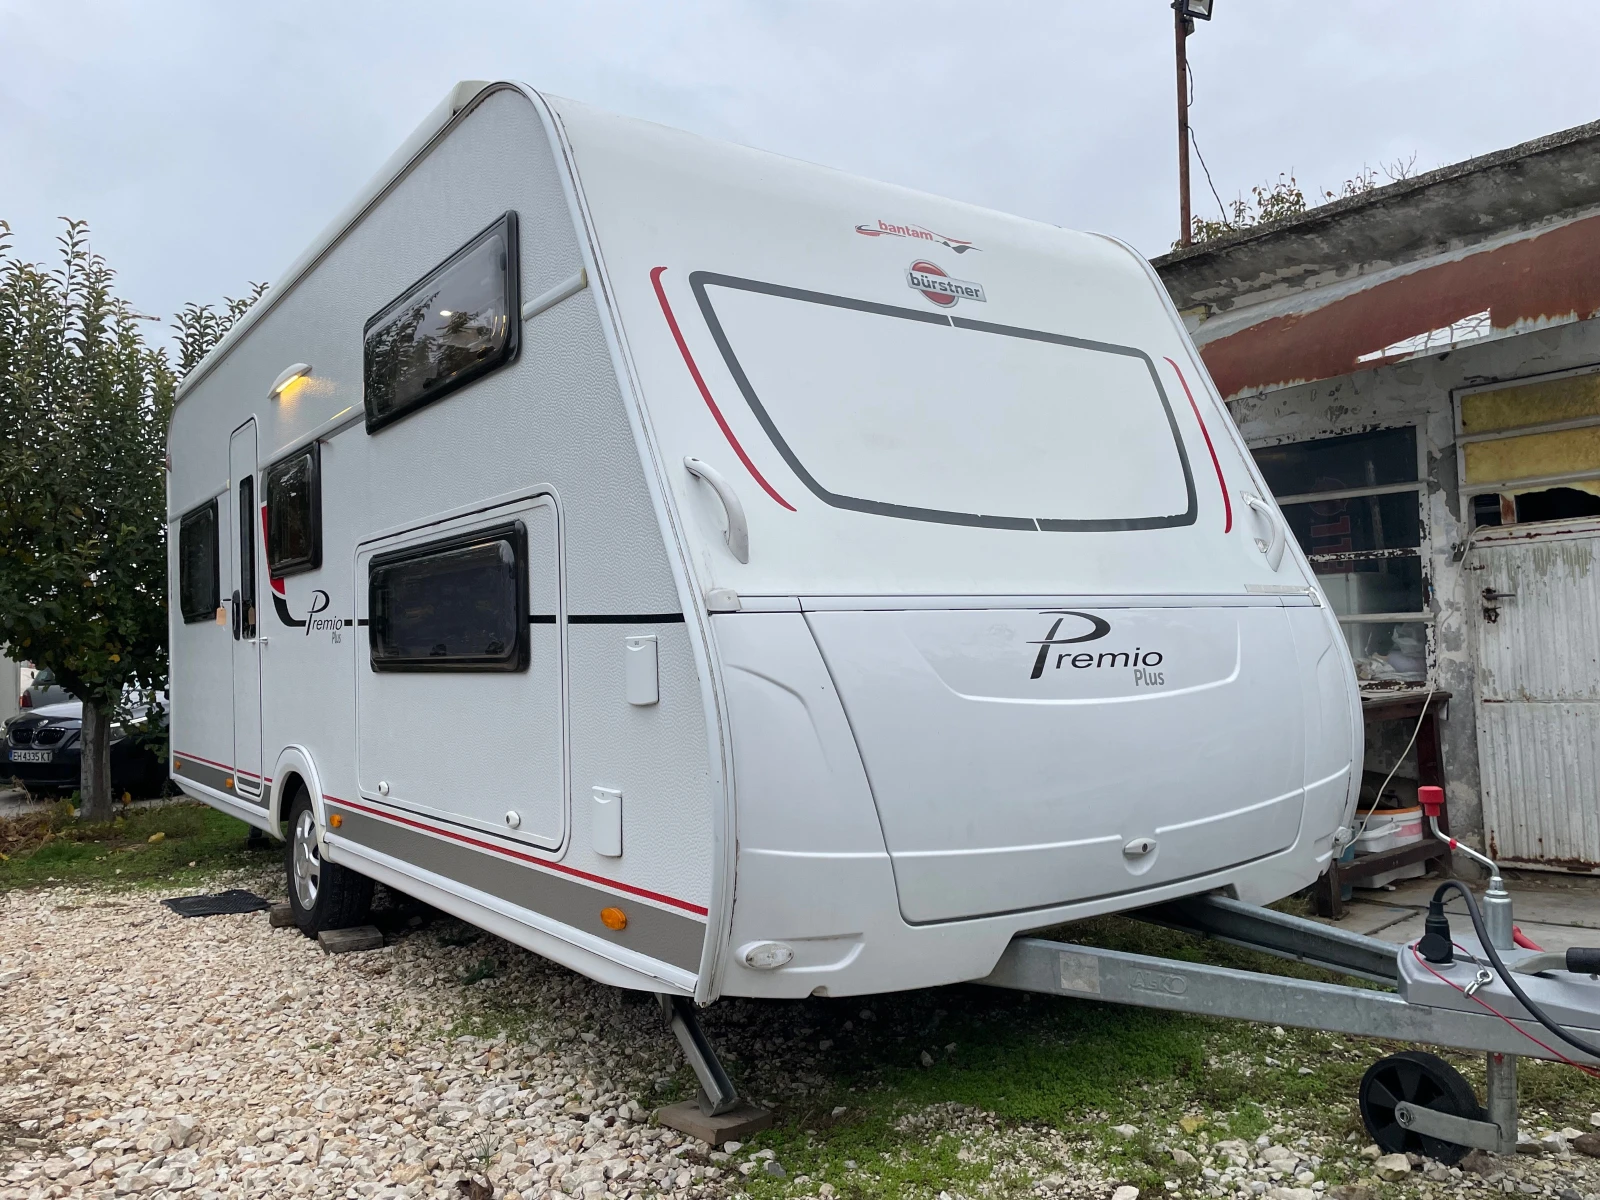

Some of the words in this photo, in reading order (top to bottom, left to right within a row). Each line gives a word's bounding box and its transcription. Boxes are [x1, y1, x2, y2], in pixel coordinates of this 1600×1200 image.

[877, 219, 934, 241] bantam
[909, 272, 981, 298] bürstner
[306, 589, 343, 637] Premio
[331, 630, 341, 644] Plus
[1025, 610, 1163, 680] Premio
[1133, 667, 1165, 687] Plus
